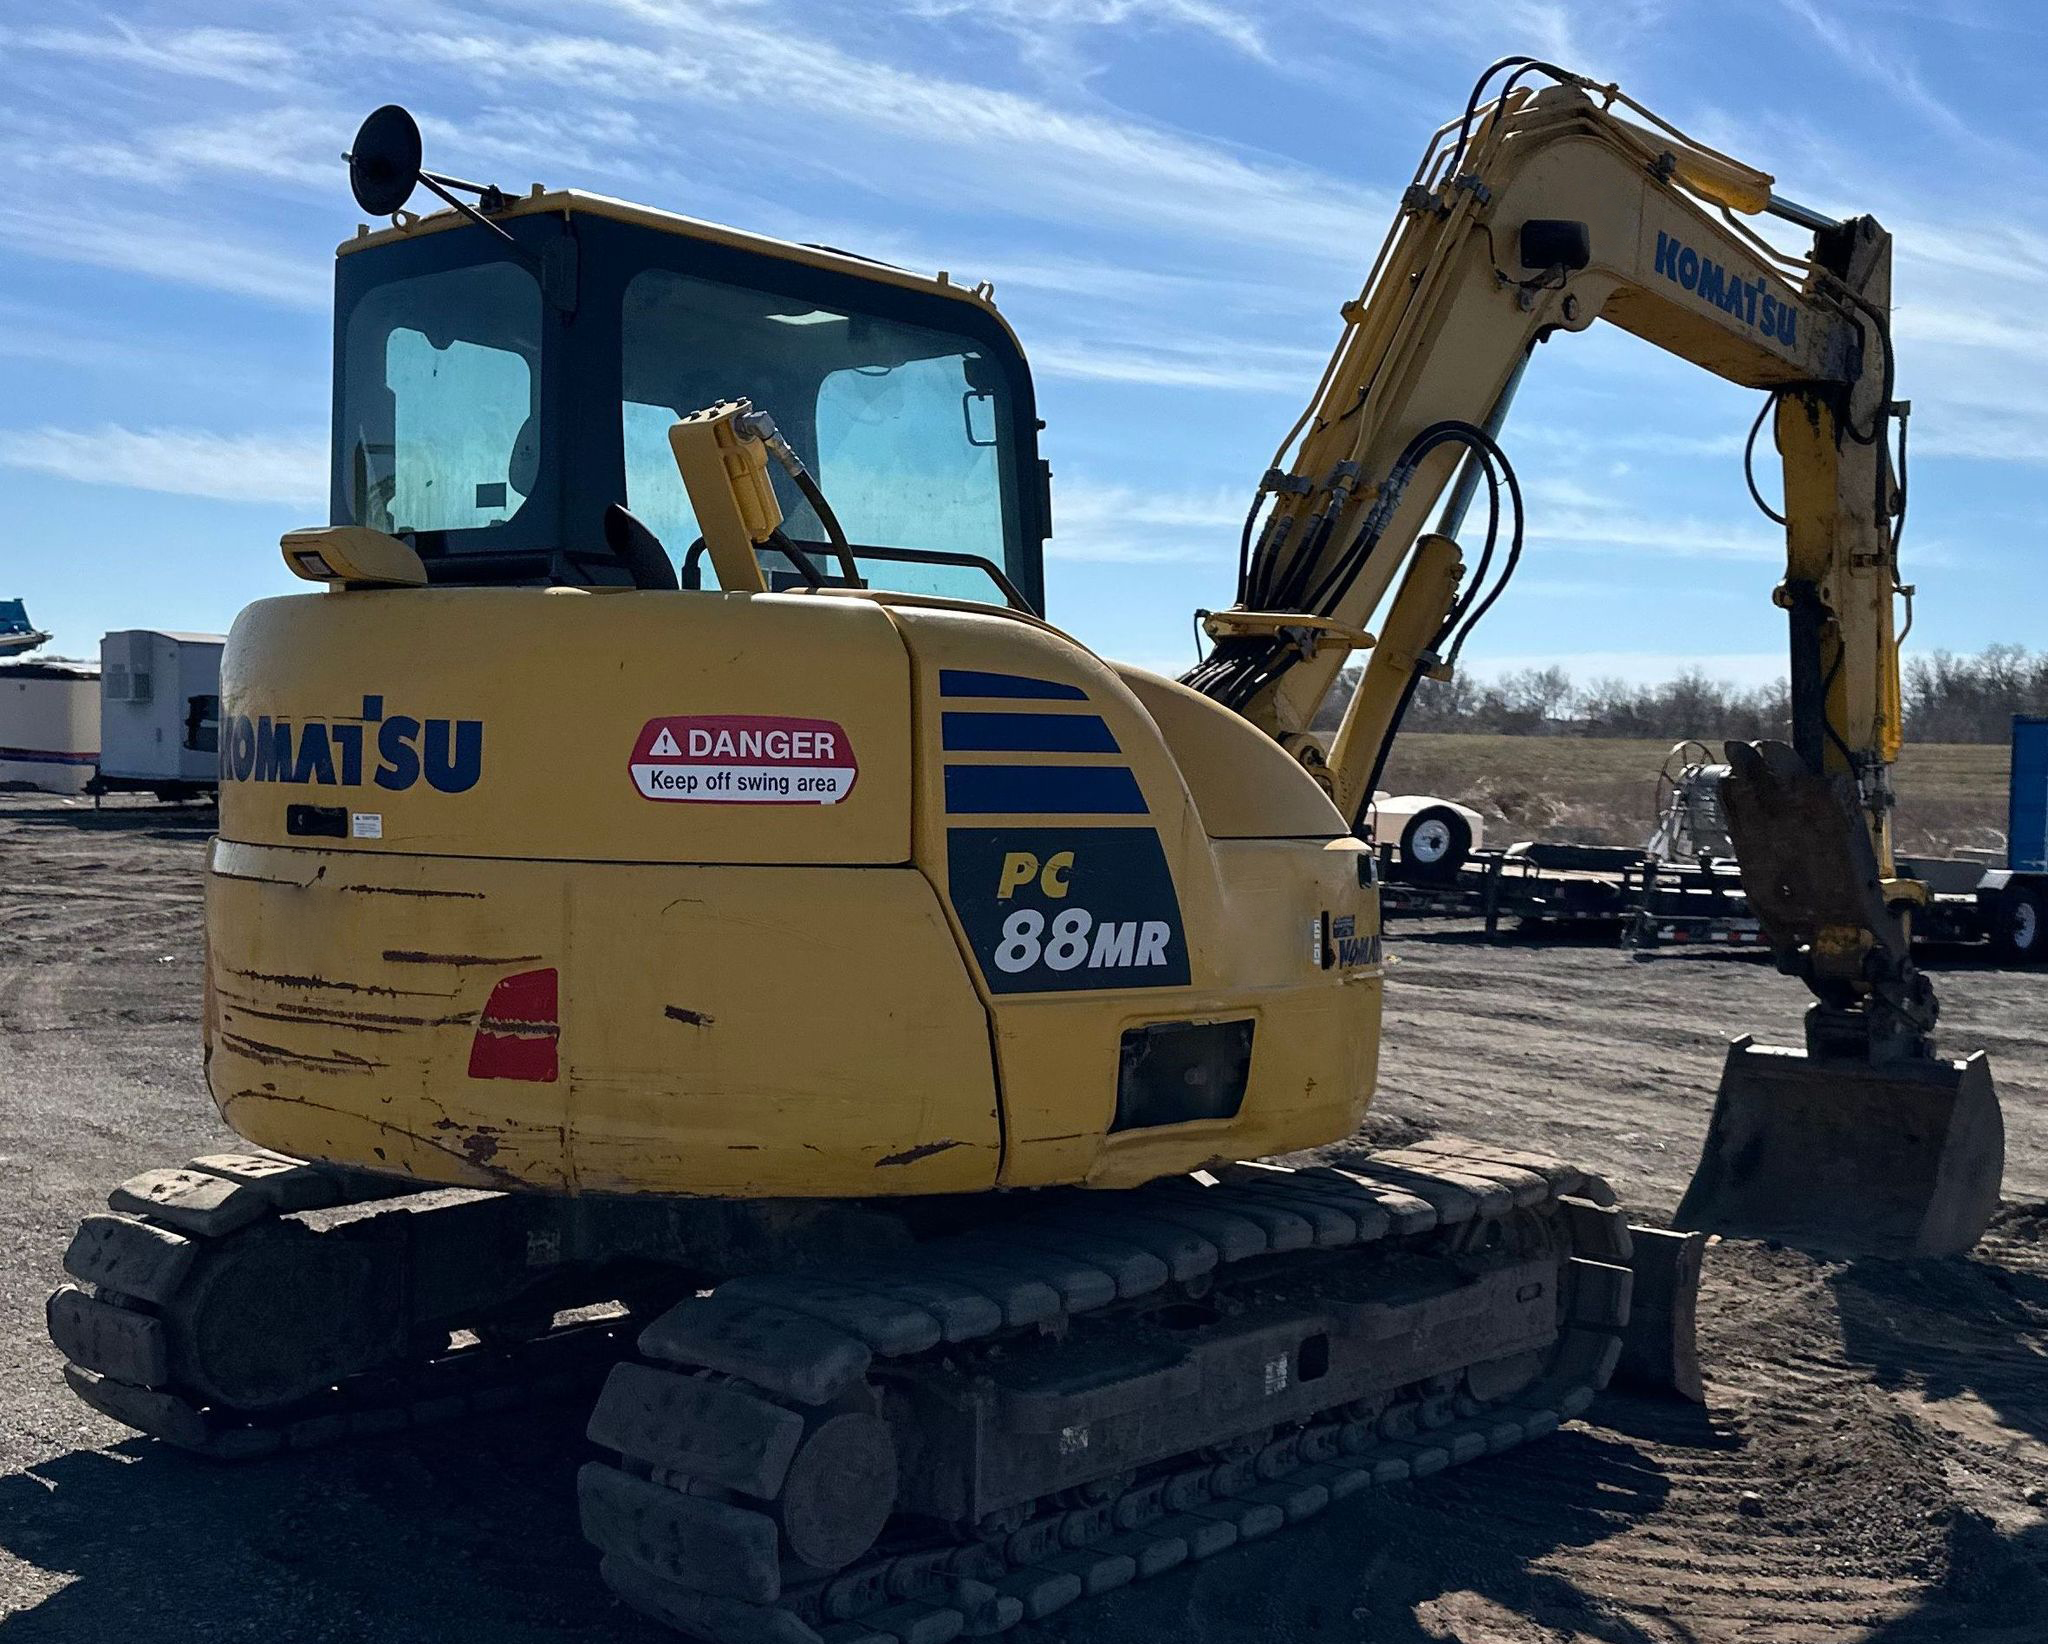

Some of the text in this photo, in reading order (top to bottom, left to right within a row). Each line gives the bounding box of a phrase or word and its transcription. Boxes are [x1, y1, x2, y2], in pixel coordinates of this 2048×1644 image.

[1655, 230, 1797, 347] KOMATSU
[219, 695, 483, 793] KOMATSU
[688, 729, 835, 760] DANGER
[651, 770, 837, 794] Keep off swing area
[997, 851, 1075, 899] PC
[994, 907, 1171, 973] 88MR
